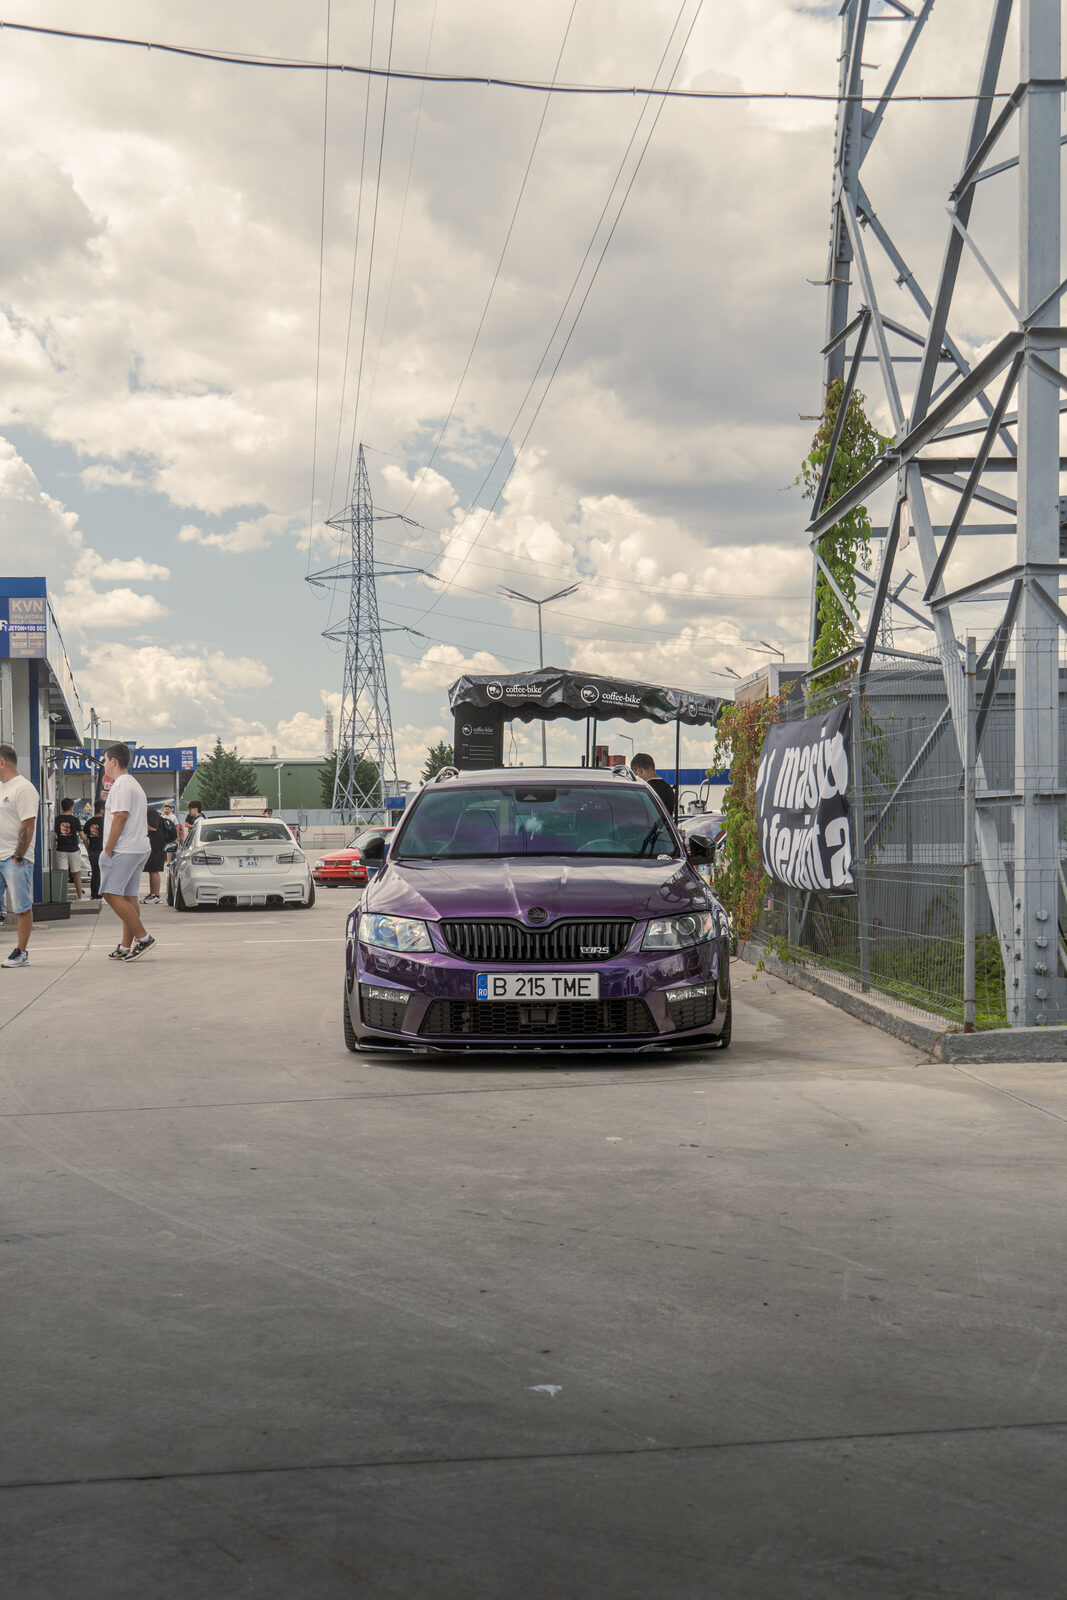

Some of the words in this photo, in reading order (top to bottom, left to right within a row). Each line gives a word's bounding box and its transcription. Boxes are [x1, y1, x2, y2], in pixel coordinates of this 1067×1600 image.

[11, 600, 43, 612] KVN
[505, 684, 542, 694] coffee-bike
[601, 691, 641, 704] coffee-bike
[478, 988, 488, 996] RO
[493, 977, 507, 996] B
[515, 977, 546, 996] 215
[551, 977, 592, 996] TME
